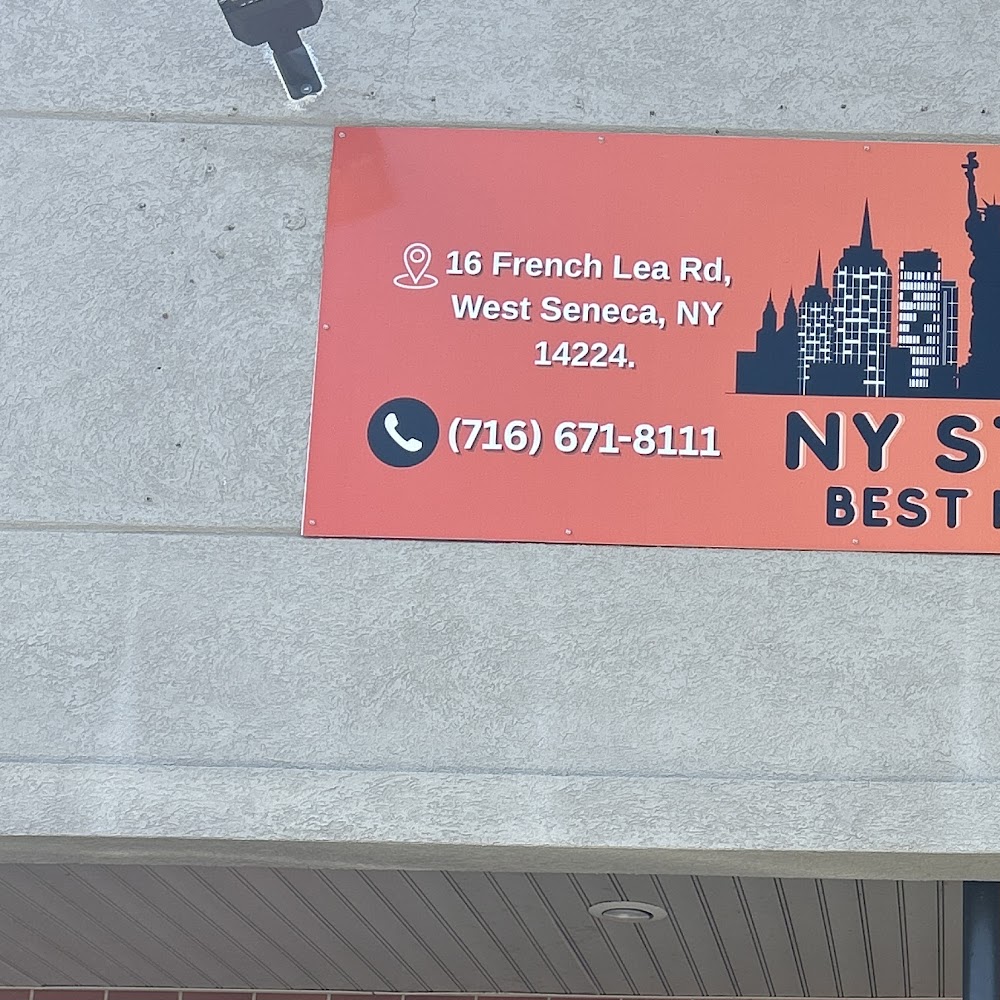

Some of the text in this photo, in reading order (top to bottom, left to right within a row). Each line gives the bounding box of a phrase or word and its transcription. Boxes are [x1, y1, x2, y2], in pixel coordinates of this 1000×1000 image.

[445, 250, 733, 287] 16 French Lea Rd,
[451, 294, 723, 329] West Seneca, NY
[534, 340, 636, 369] 14224.
[448, 416, 722, 458] (716) 671-8111
[785, 409, 905, 472] NY
[825, 486, 971, 529] BEST
